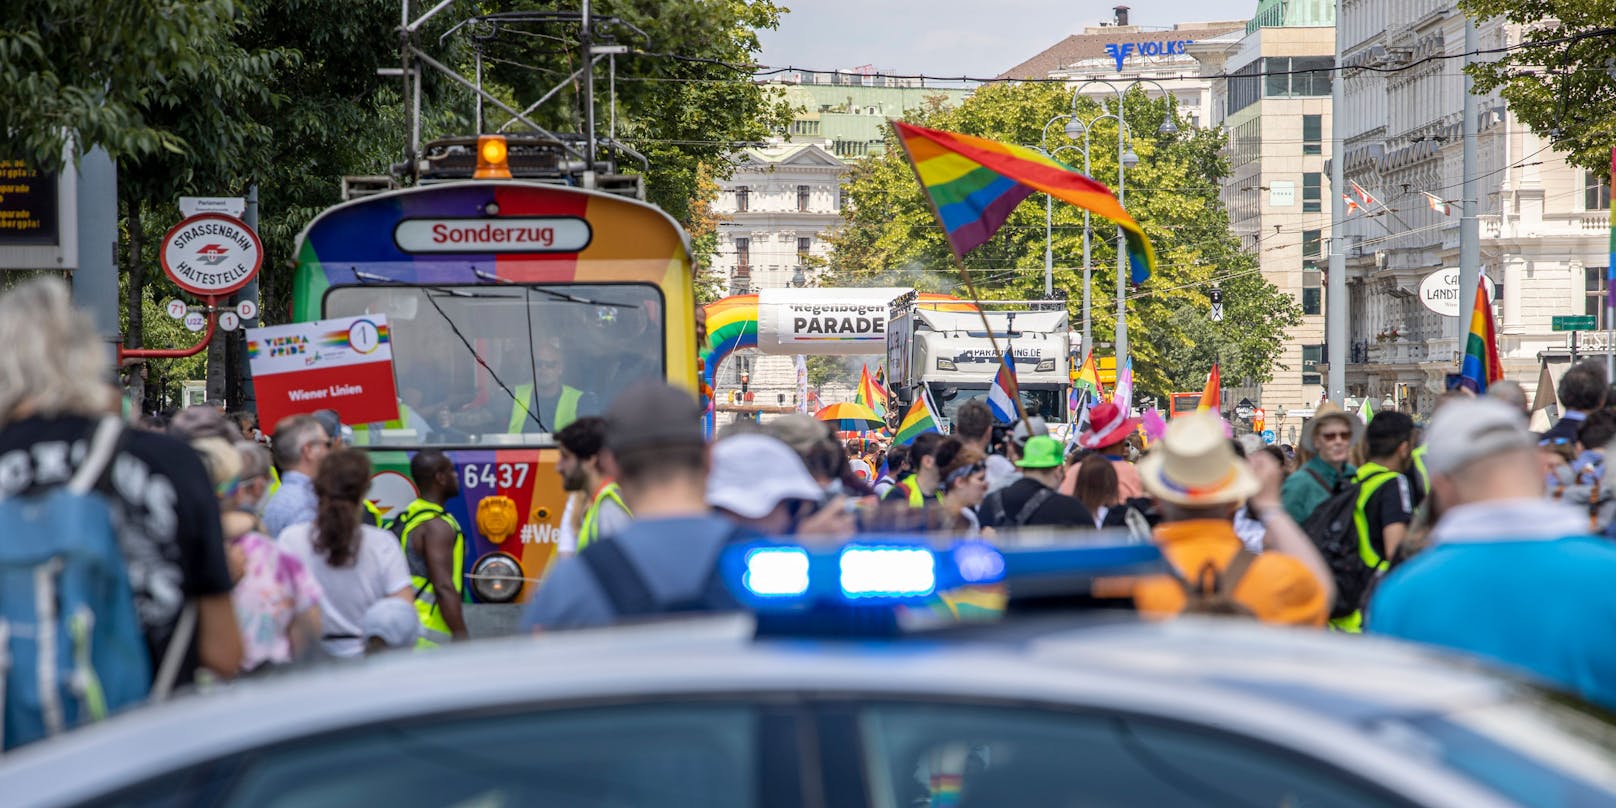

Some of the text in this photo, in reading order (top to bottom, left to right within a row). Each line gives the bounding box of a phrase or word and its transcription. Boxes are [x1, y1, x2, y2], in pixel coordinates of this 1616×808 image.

[1137, 40, 1194, 56] VOLKS
[174, 224, 252, 251] STRASSENBAHN
[432, 224, 554, 247] Sonderzug
[176, 261, 248, 285] HALTESTELLE
[1444, 275, 1460, 286] CA
[171, 304, 184, 315] 71
[242, 304, 251, 315] D
[226, 316, 232, 326] 1
[794, 317, 885, 334] PARADE
[264, 335, 309, 347] VIENNA
[357, 326, 367, 345] 1
[270, 345, 306, 357] PRIDE
[288, 384, 363, 402] Wiener Linien
[463, 463, 529, 488] 6437
[520, 523, 560, 545] #We
